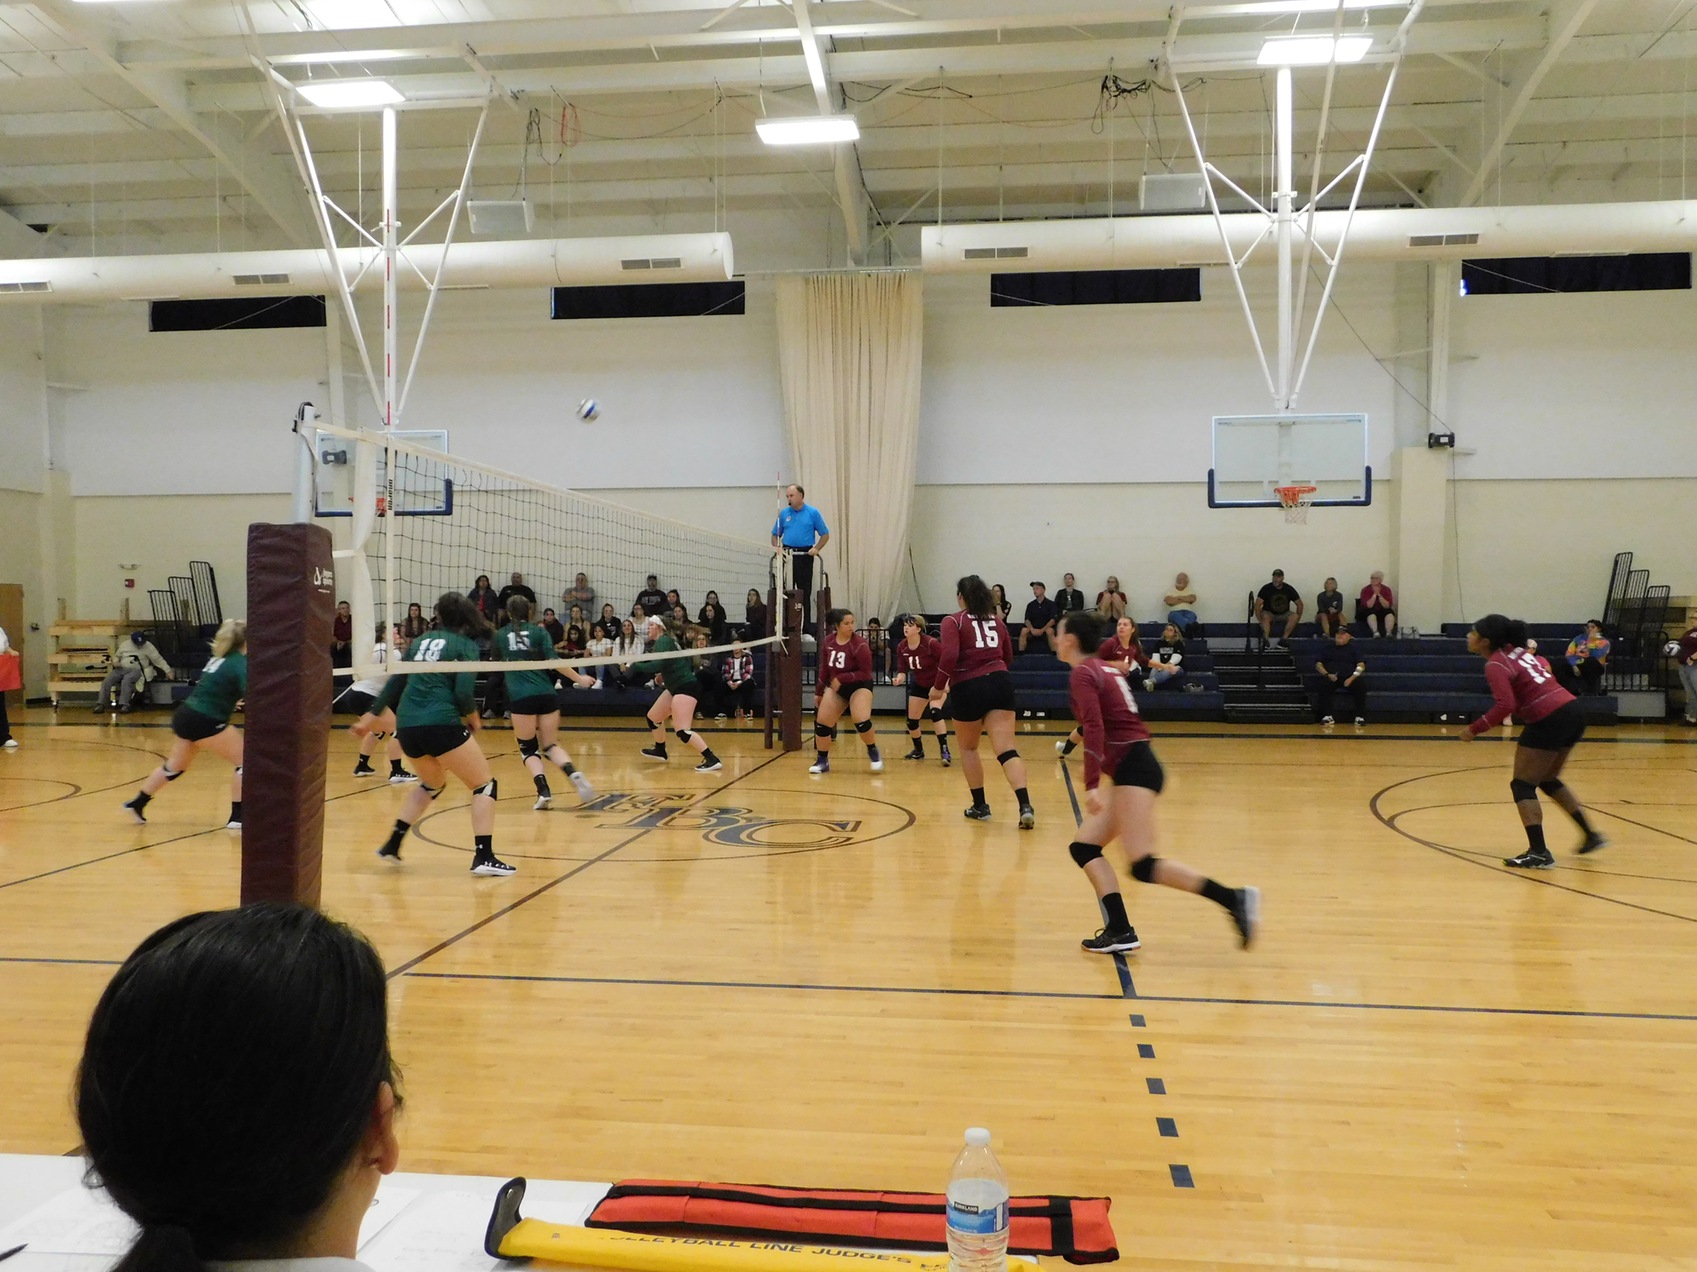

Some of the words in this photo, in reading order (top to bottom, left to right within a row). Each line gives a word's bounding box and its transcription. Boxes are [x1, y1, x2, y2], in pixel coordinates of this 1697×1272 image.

[972, 620, 999, 648] 15
[413, 638, 446, 662] 18
[828, 650, 846, 669] 13
[908, 655, 922, 670] 11
[749, 1243, 802, 1254] LINE
[811, 1248, 912, 1264] JUDGE'S
